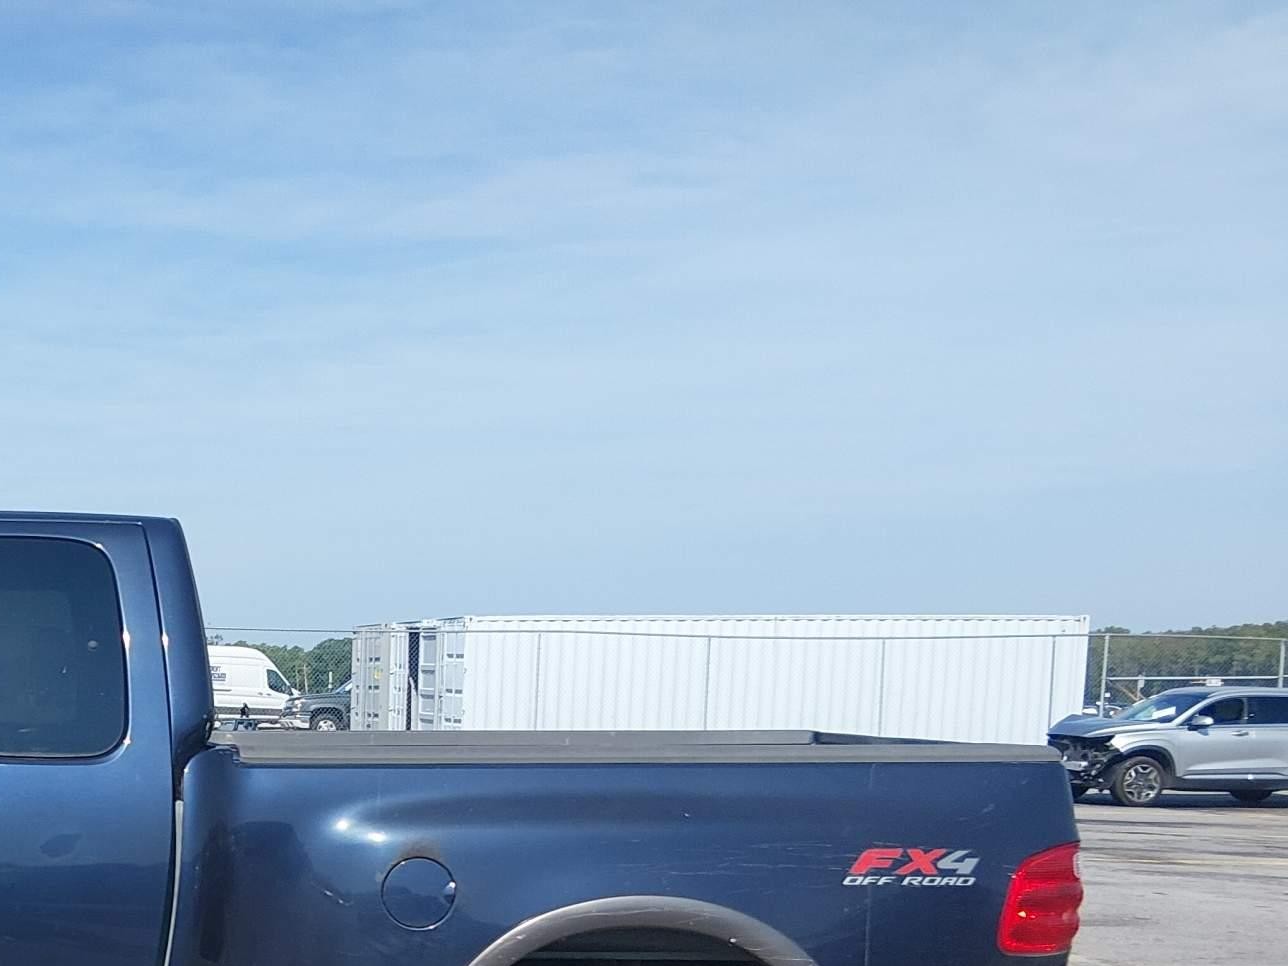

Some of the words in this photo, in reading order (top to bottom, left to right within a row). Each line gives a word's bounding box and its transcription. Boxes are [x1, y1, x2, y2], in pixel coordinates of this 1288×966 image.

[848, 848, 980, 875] FX4
[842, 876, 897, 886] OFF
[900, 876, 977, 886] ROAD
